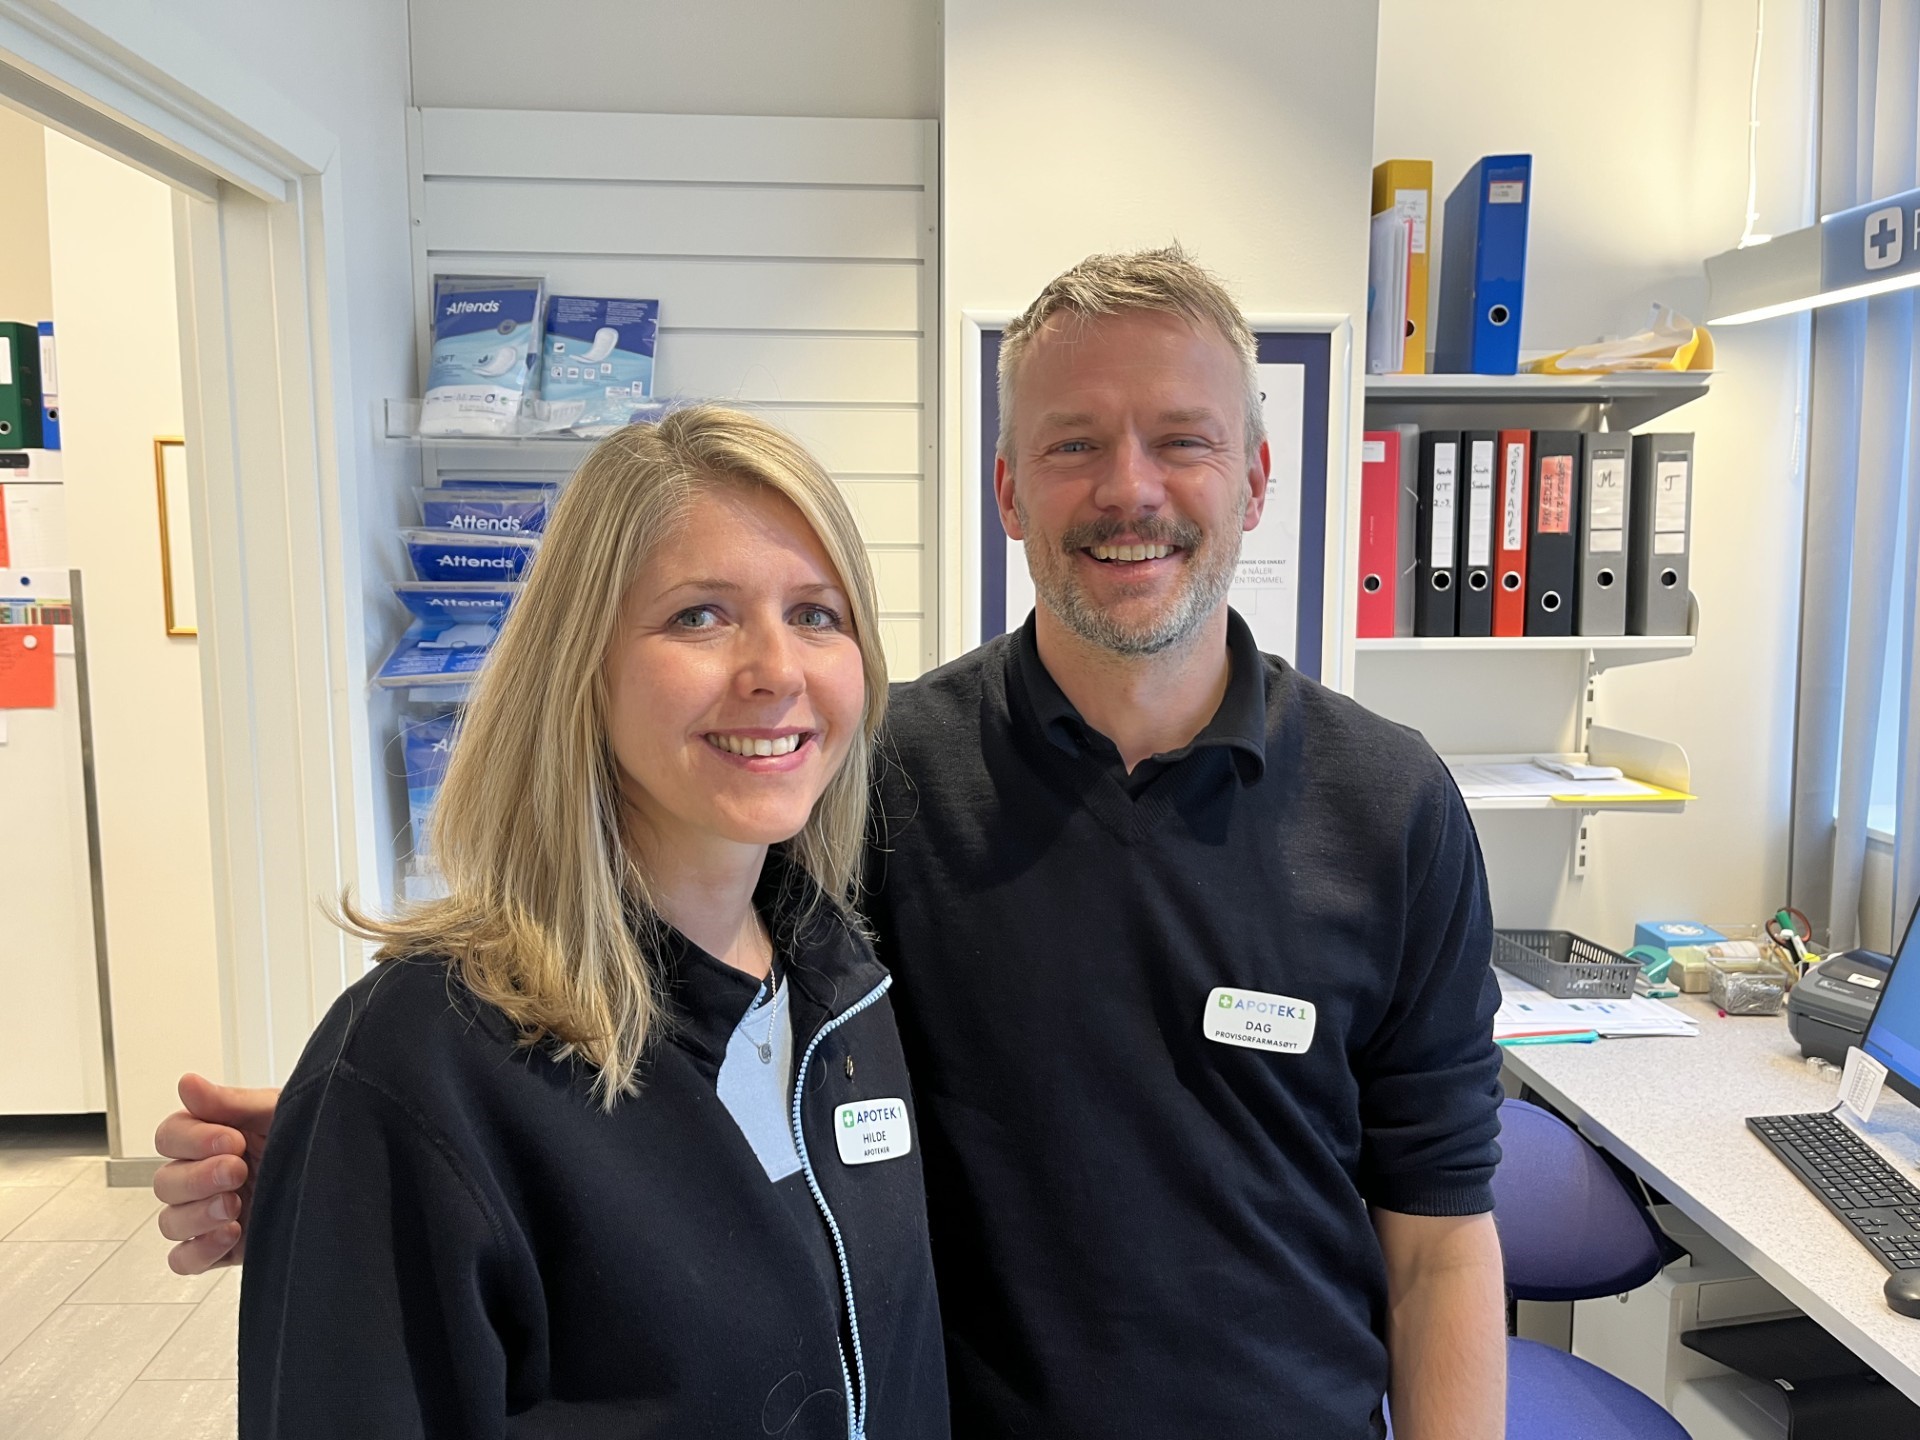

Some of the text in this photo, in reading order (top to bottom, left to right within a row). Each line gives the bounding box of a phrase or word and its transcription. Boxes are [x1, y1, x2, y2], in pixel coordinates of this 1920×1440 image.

[446, 300, 500, 315] Attends
[1597, 470, 1616, 488] M
[446, 514, 520, 531] Attends
[436, 554, 514, 568] Attends
[1246, 576, 1283, 584] TROMMEL
[425, 598, 504, 607] Attends
[1235, 999, 1306, 1020] APOTEK 1
[1245, 1021, 1272, 1033] DAG
[1215, 1030, 1298, 1049] PROVISORFARMASØYT
[857, 1107, 897, 1124] APOTEK
[863, 1130, 887, 1143] HILDE
[864, 1146, 890, 1157] APOTEKER
